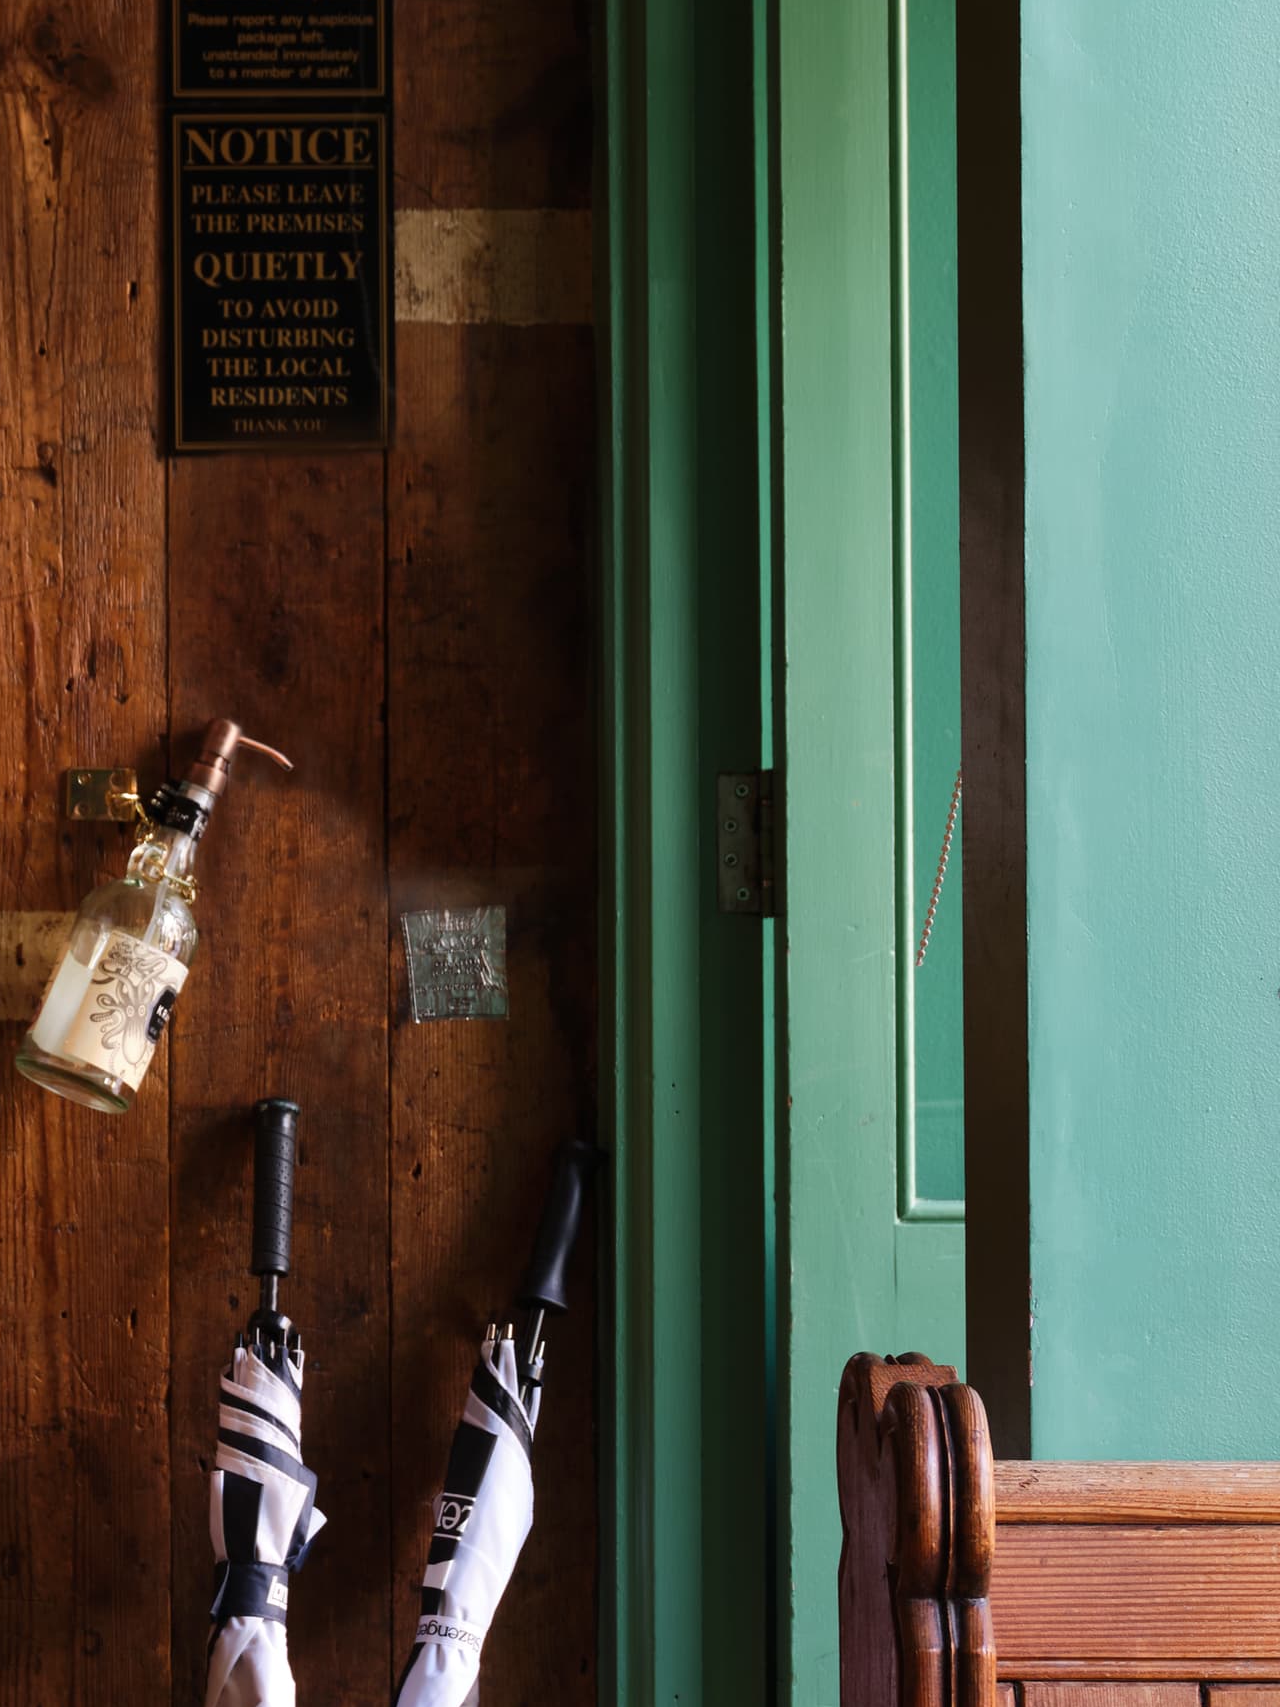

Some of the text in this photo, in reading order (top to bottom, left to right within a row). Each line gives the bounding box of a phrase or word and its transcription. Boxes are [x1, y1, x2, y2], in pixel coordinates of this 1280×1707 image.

[188, 12, 229, 27] Please
[232, 13, 276, 30] report
[280, 15, 304, 30] any
[237, 30, 297, 48] packages
[202, 47, 360, 64] unattended immediately
[208, 67, 225, 79] to
[241, 66, 295, 80] member
[298, 66, 313, 79] of
[186, 128, 371, 165] NOTICE
[192, 184, 364, 205] PLEASE LEAVE
[192, 213, 364, 234] THE PREMISES
[193, 251, 364, 287] QUIETLY
[218, 298, 339, 319] TO AVOID
[202, 327, 355, 349] DISTURBING
[206, 357, 351, 377] THE LOCAL
[210, 386, 348, 407] RESIDENTS
[232, 417, 327, 433] THANK YOU
